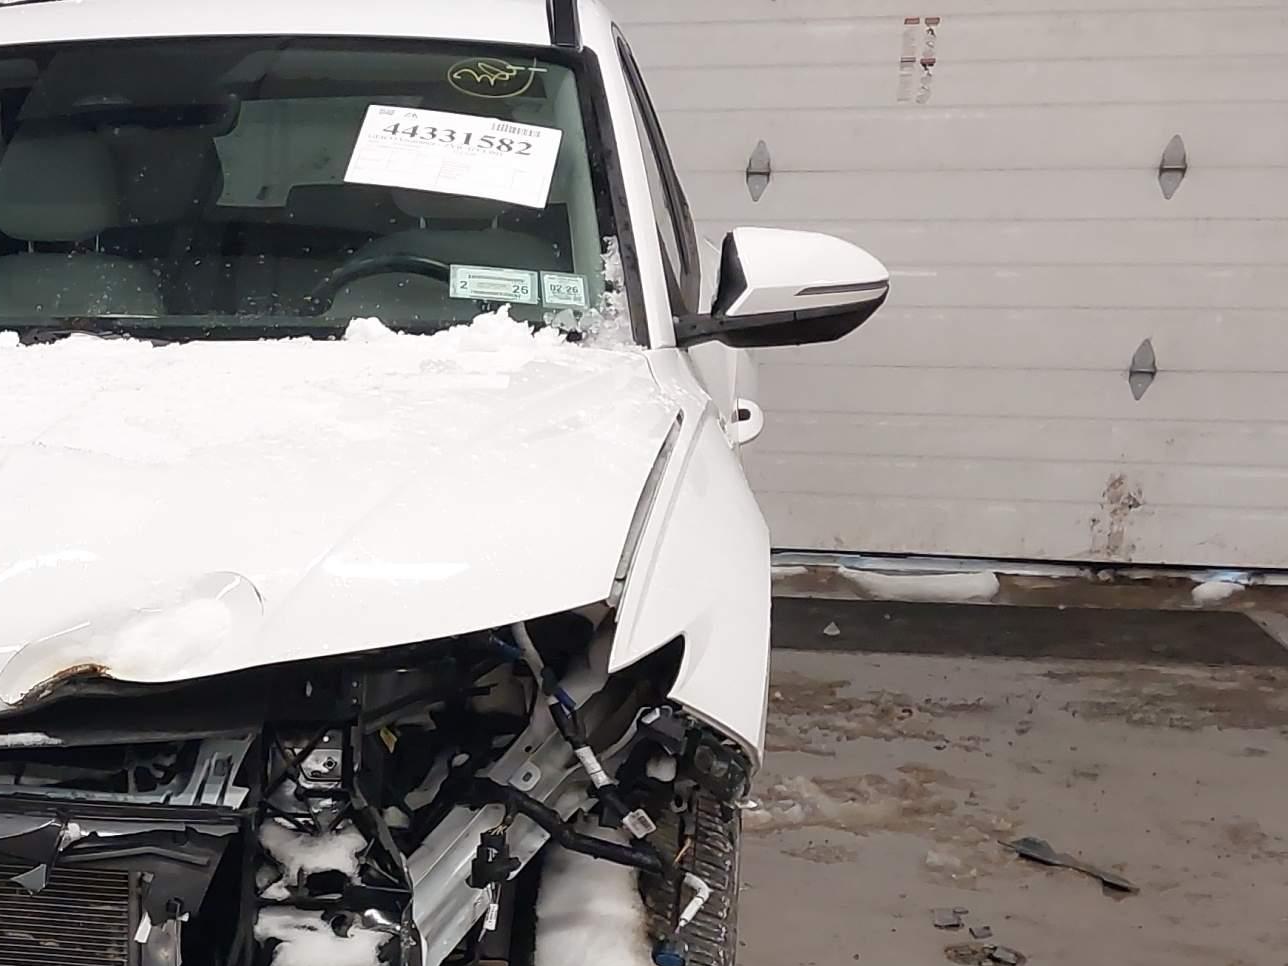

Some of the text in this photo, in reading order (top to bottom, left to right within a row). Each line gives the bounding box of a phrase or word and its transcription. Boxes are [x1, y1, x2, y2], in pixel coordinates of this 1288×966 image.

[382, 122, 533, 156] 44331582
[460, 280, 468, 289] 2
[512, 285, 528, 295] 26
